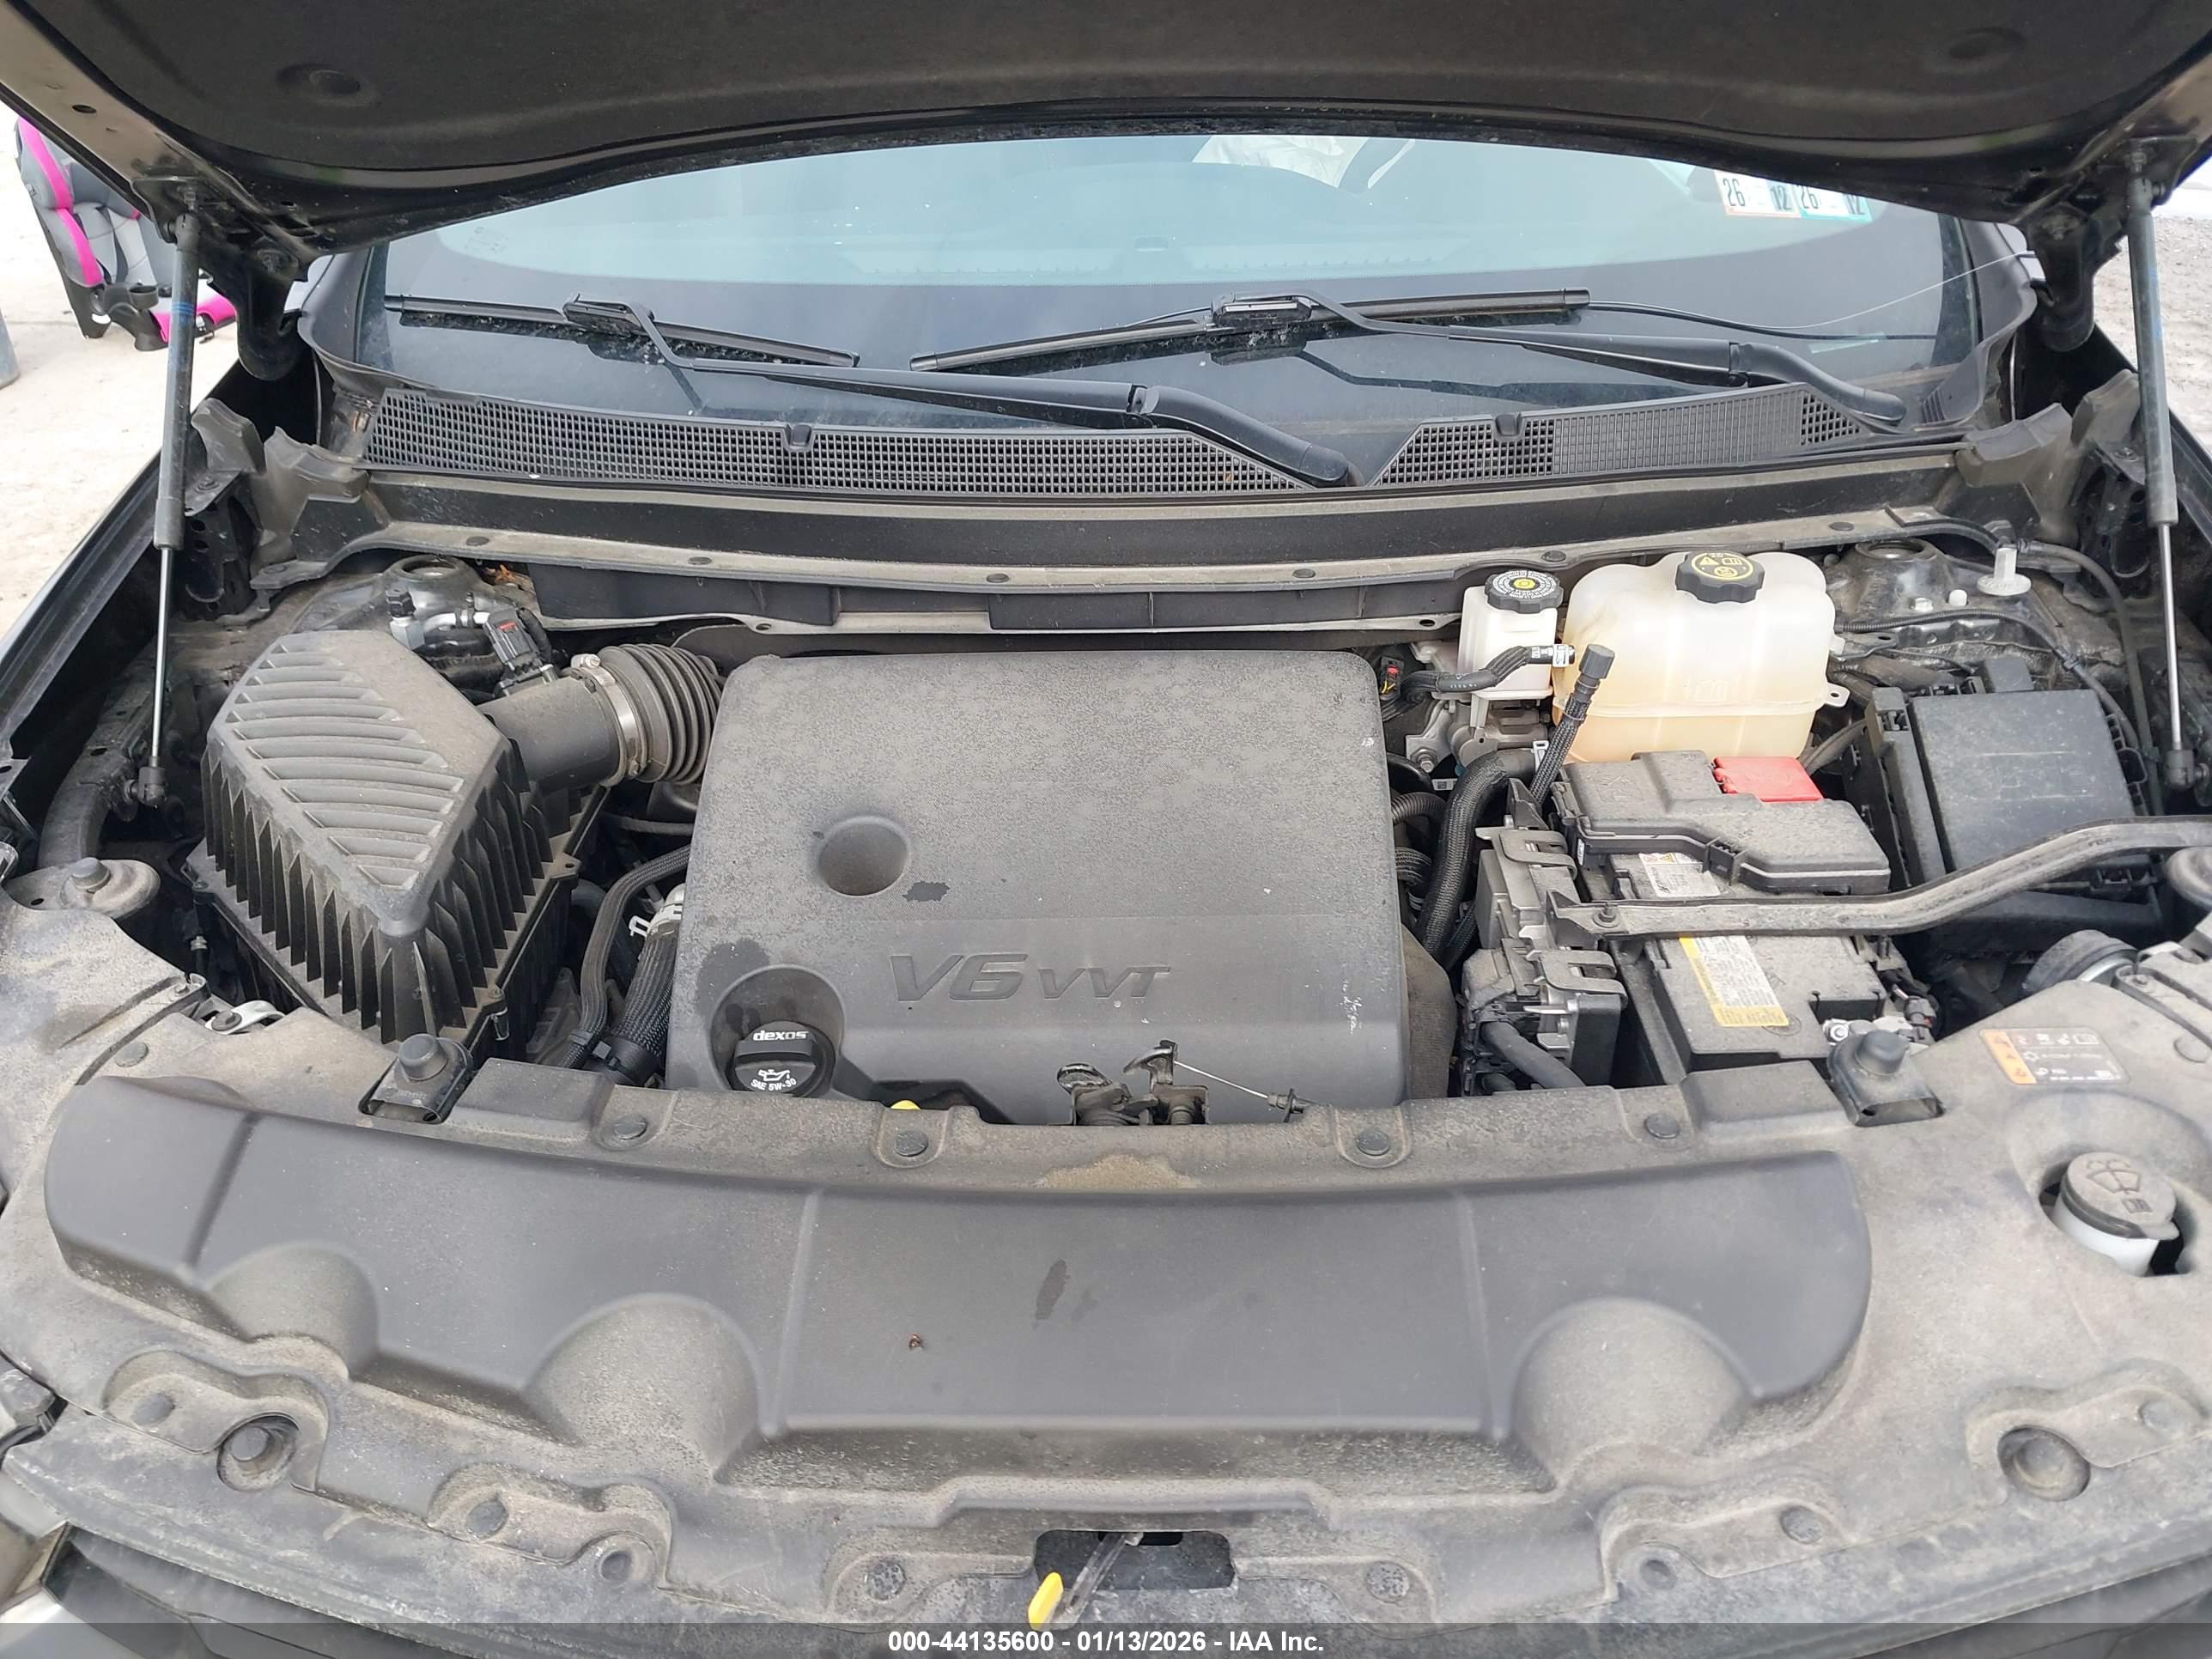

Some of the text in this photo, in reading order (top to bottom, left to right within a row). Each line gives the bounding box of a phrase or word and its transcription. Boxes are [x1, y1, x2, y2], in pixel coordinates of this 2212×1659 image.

[1723, 177, 1793, 211] 26 12
[1796, 185, 1820, 210] 26
[890, 952, 1172, 1002] V6 VVT
[753, 1030, 809, 1041] dexos
[750, 1078, 797, 1091] SAE 5W-30
